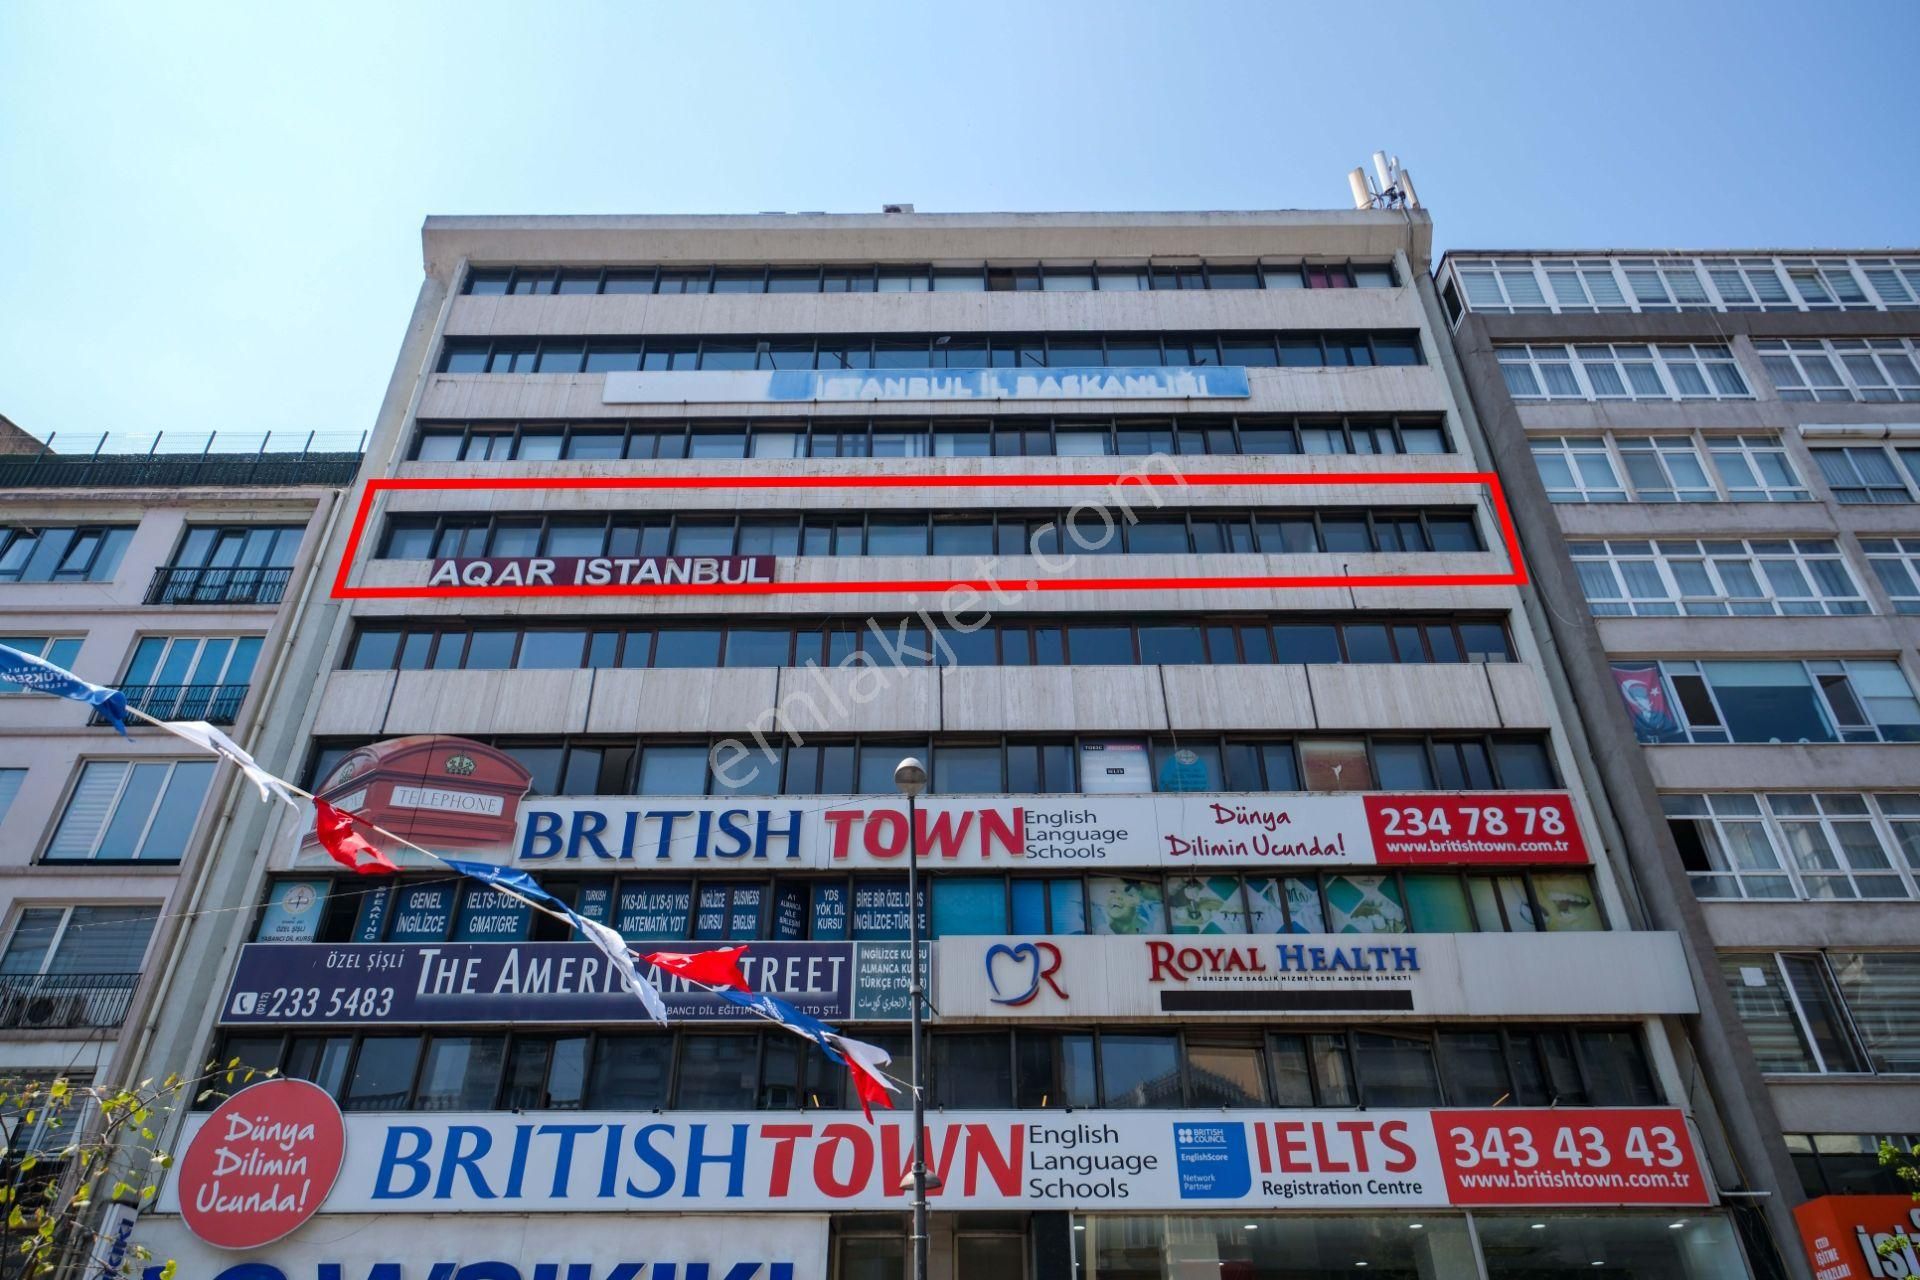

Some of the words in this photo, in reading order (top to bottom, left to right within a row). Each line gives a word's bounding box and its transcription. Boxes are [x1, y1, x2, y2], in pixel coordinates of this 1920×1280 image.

[428, 559, 556, 587] AQAR
[574, 558, 770, 585] ISTANBUL
[400, 788, 498, 814] TELEPHONE
[1023, 808, 1098, 828] English
[1211, 802, 1292, 830] Dünya
[1379, 806, 1451, 836] 234
[1458, 806, 1516, 836] 78
[1522, 806, 1567, 836] 78
[518, 811, 802, 862] BRITISH
[824, 806, 1024, 861] TOWN
[1024, 826, 1129, 845] Language
[1025, 844, 1107, 860] Schools
[1164, 833, 1249, 858] Dilimin
[1252, 834, 1347, 858] Ucunda!
[1386, 837, 1570, 855] www.britishtown.com.tr
[409, 892, 442, 909] GENEL
[467, 892, 526, 909] IELTS-TOEFL
[674, 893, 690, 910] YKS
[700, 889, 726, 908] İNGİLİZCE
[824, 889, 839, 901] YDS
[856, 889, 873, 907] BİRE
[873, 889, 886, 907] BİR
[886, 889, 904, 907] ÖZEL
[904, 892, 924, 907] DS
[364, 886, 387, 940] SPEAKING
[815, 903, 832, 916] YÖK
[834, 902, 846, 916] DİL
[396, 912, 446, 932] İNGİLİZCE
[469, 915, 519, 933] GMAT/GRE
[622, 913, 669, 932] MATEMATİK
[670, 916, 686, 932] YDT
[698, 914, 724, 930] KURSU
[732, 914, 756, 930] ENGLISH
[817, 917, 843, 930] KURSU
[326, 949, 362, 969] ÖZEL
[367, 949, 406, 972] ŞİŞLİ
[861, 948, 899, 960] İNGİLİZCE
[1145, 941, 1267, 982] ROYAL
[1276, 944, 1421, 972] HEALTH
[415, 948, 482, 996] THE
[861, 964, 899, 974] ALMANCA
[860, 976, 892, 990] TÜRKÇE
[266, 987, 319, 1018] 233
[324, 986, 395, 1018] 5483
[699, 1005, 715, 1015] DİL
[718, 1004, 753, 1015] EĞİTİM
[802, 1006, 820, 1015] LTD
[823, 1004, 842, 1017] ŞTİ.
[224, 1111, 316, 1150] Dünya
[1029, 1124, 1119, 1149] English
[1193, 1128, 1224, 1136] BRITISH
[1194, 1135, 1227, 1143] COUNCIL
[1253, 1119, 1418, 1174] IELTS
[1449, 1126, 1540, 1168] 343
[1552, 1126, 1612, 1168] 43
[1625, 1126, 1684, 1168] 43
[212, 1147, 308, 1178] Dilimin
[370, 1123, 752, 1200] BRITISH
[759, 1122, 1026, 1199] TOWN
[1030, 1150, 1158, 1176] Language
[1181, 1152, 1229, 1163] EnglishScore
[1183, 1173, 1217, 1182] Network
[1184, 1182, 1213, 1191] Partner
[1459, 1168, 1691, 1189] www.britishtown.com.tr
[196, 1179, 311, 1214] Ucunda!
[1029, 1176, 1130, 1199] Schools
[1262, 1178, 1352, 1199] Registration
[1356, 1178, 1424, 1196] Centre
